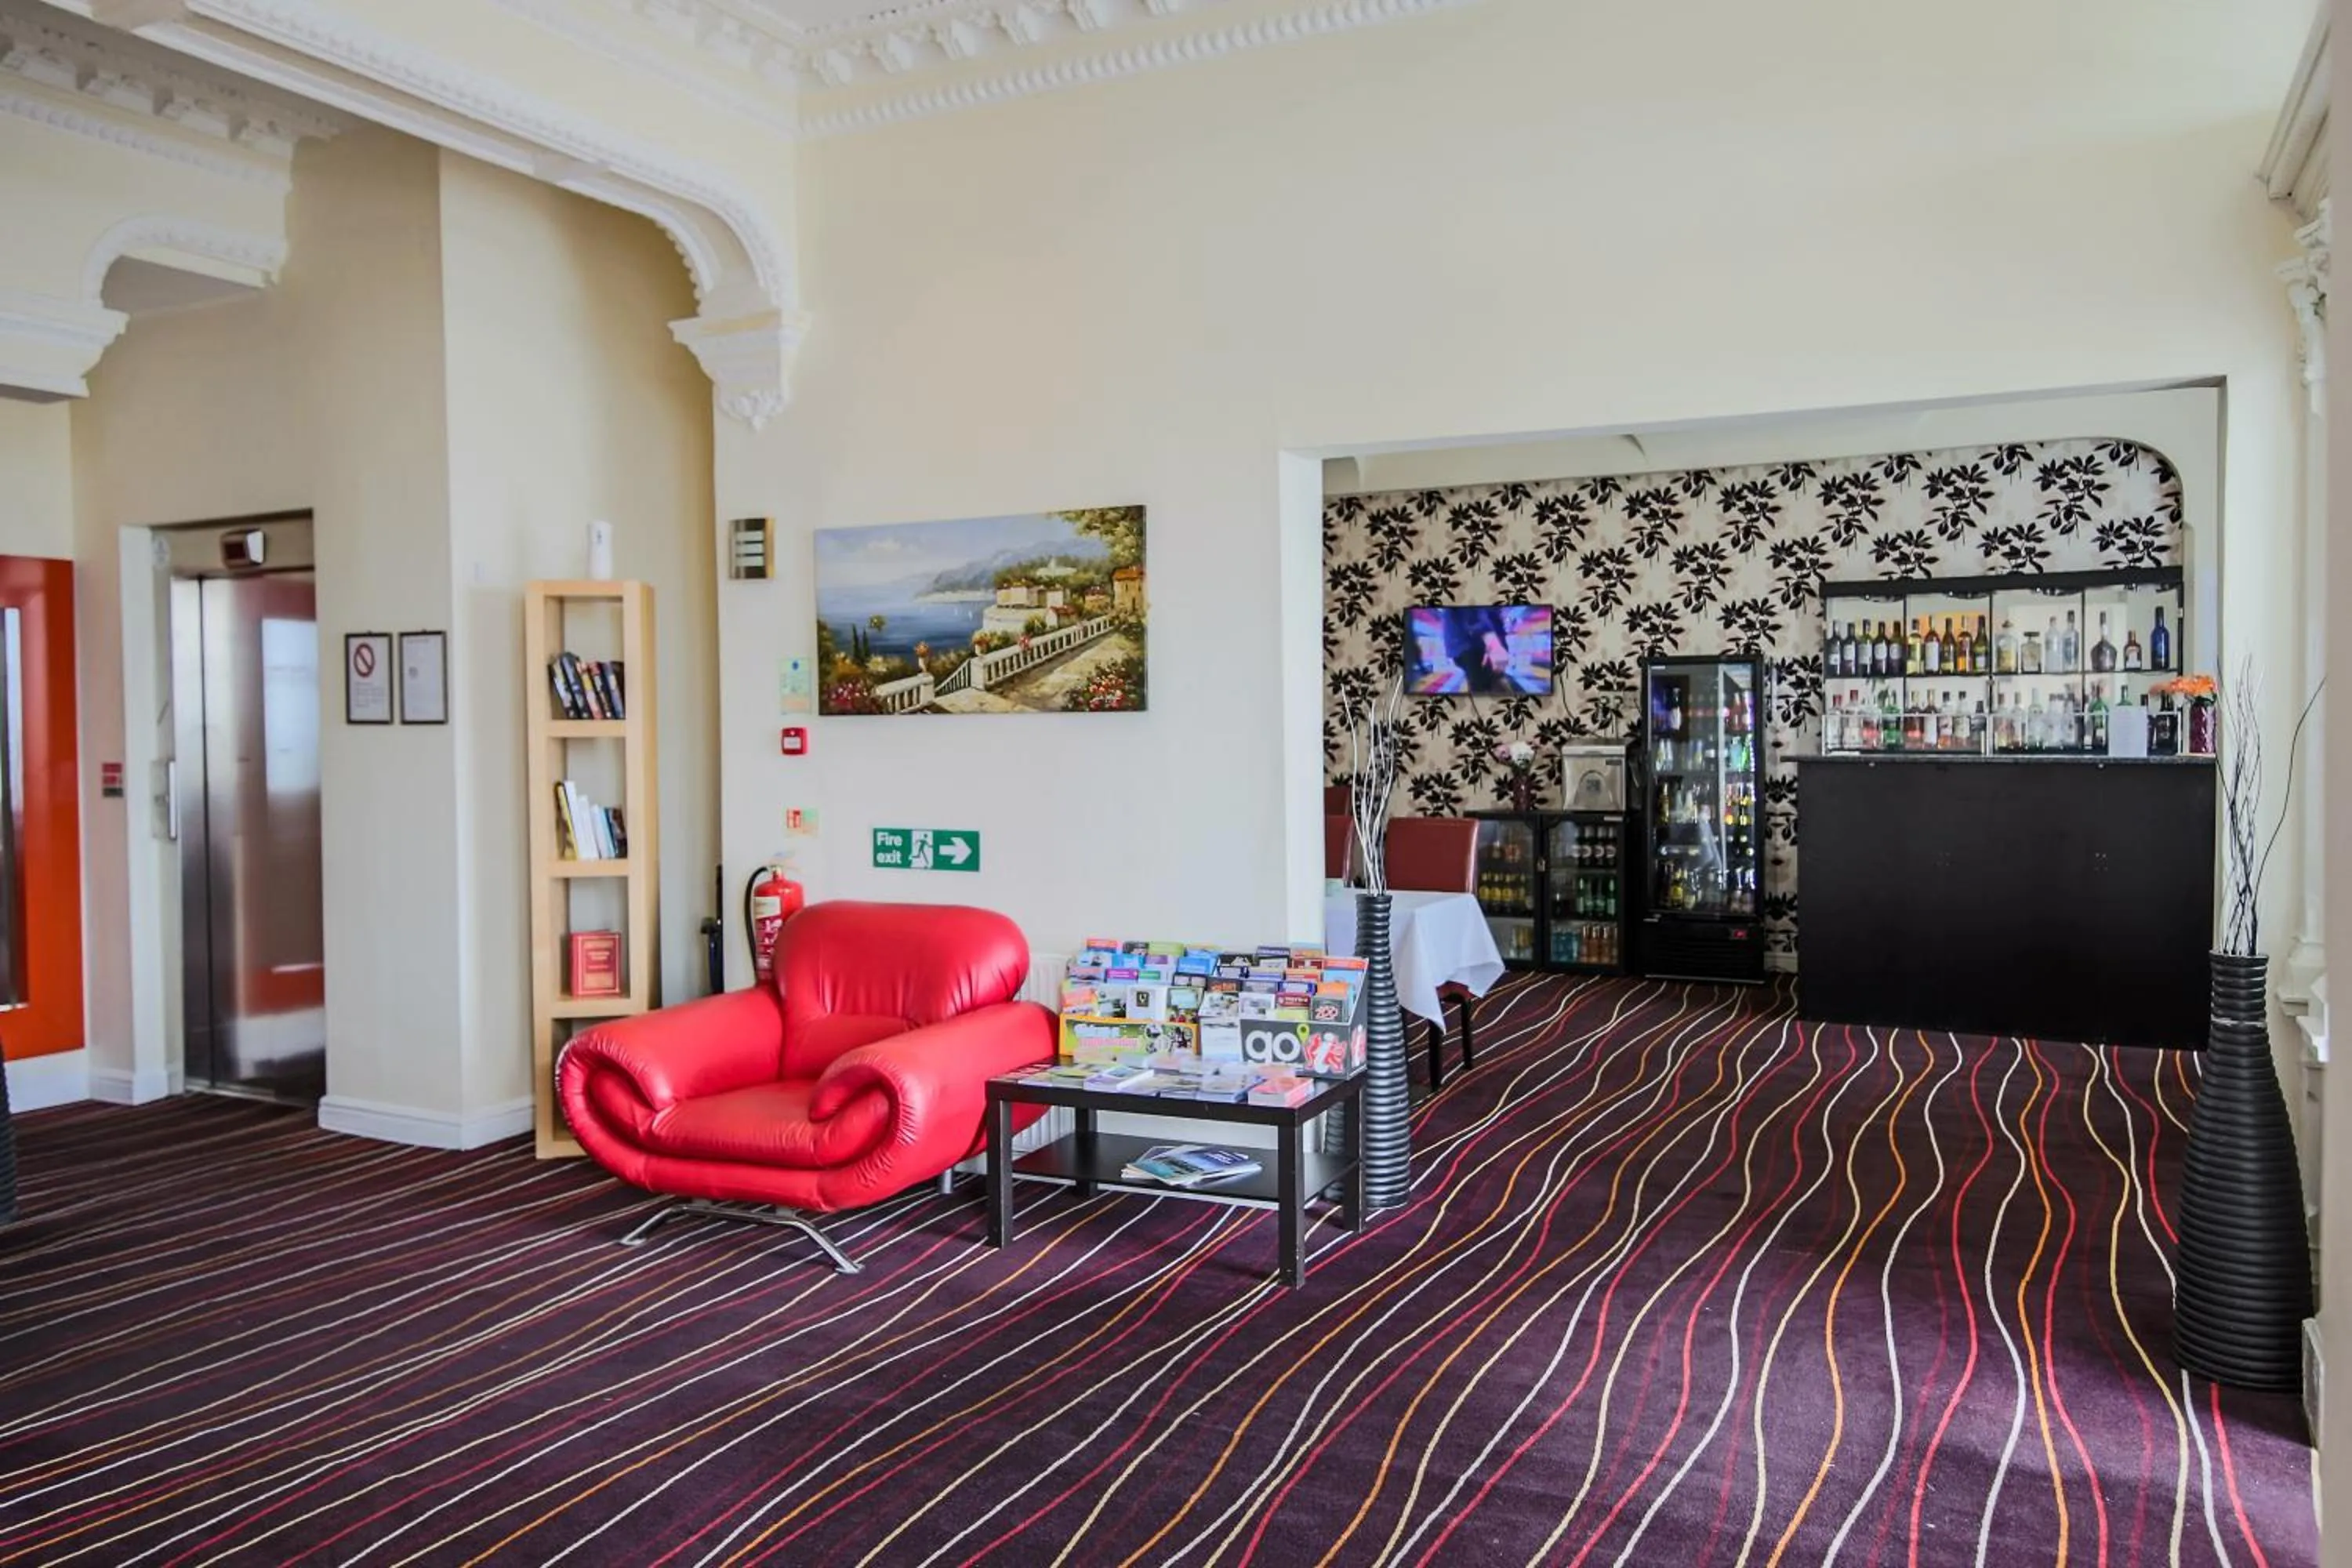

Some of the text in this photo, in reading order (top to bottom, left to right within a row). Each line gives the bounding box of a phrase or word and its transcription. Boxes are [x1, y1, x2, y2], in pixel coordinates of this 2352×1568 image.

[876, 832, 903, 847] Fire
[876, 851, 902, 864] exit
[1245, 1029, 1301, 1064] go
